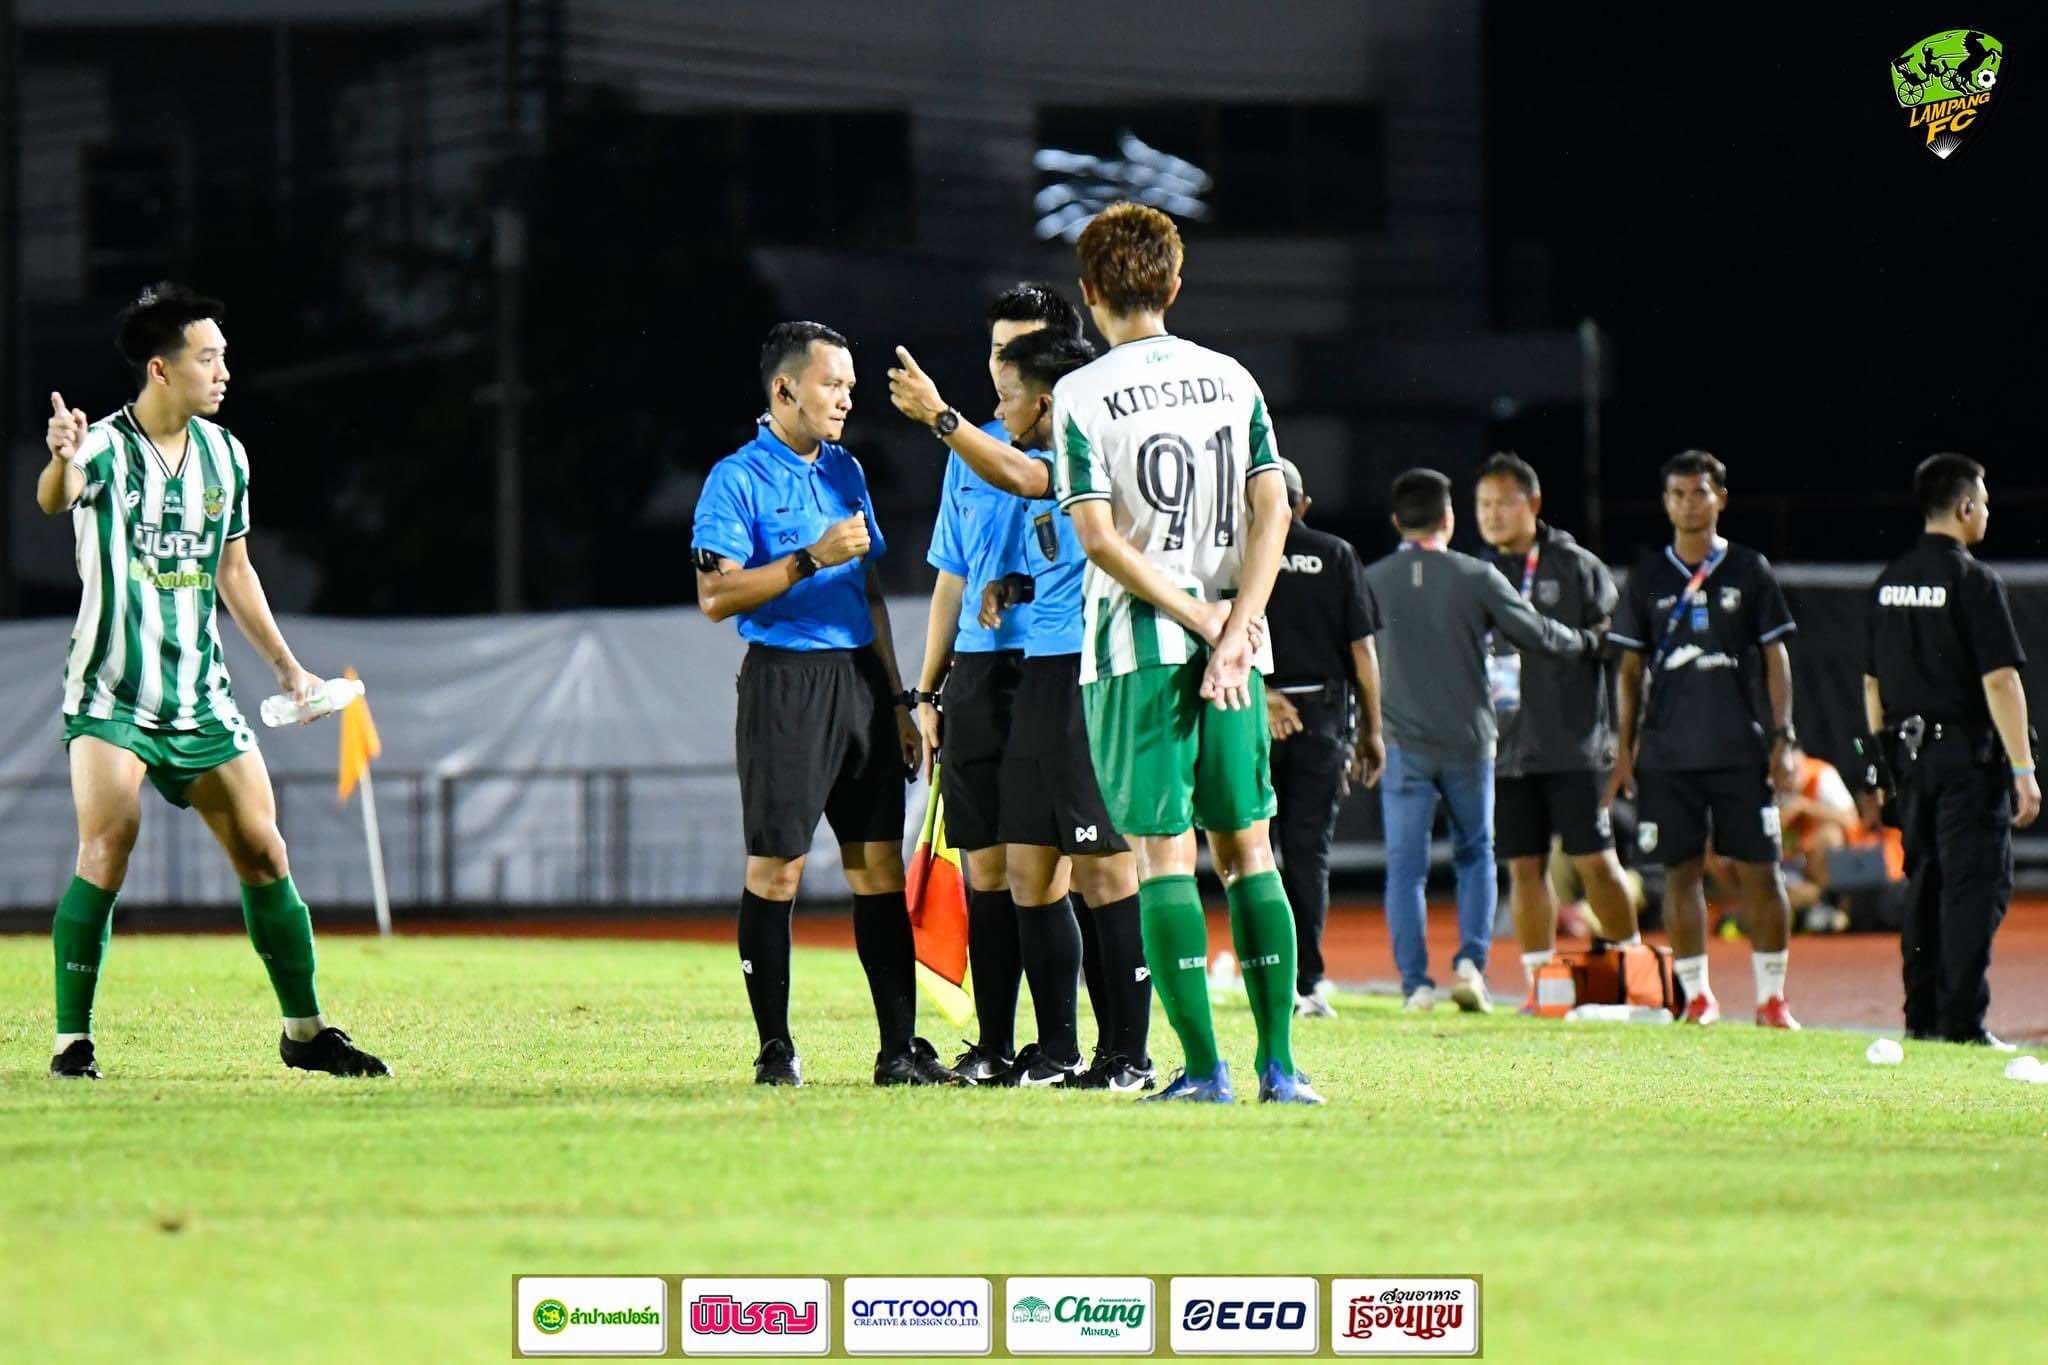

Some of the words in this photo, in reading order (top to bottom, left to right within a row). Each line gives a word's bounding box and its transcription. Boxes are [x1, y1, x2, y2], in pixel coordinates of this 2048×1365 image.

[1136, 424, 1236, 551] 91
[1280, 554, 1322, 574] ARD
[1879, 585, 1947, 608] GUARD
